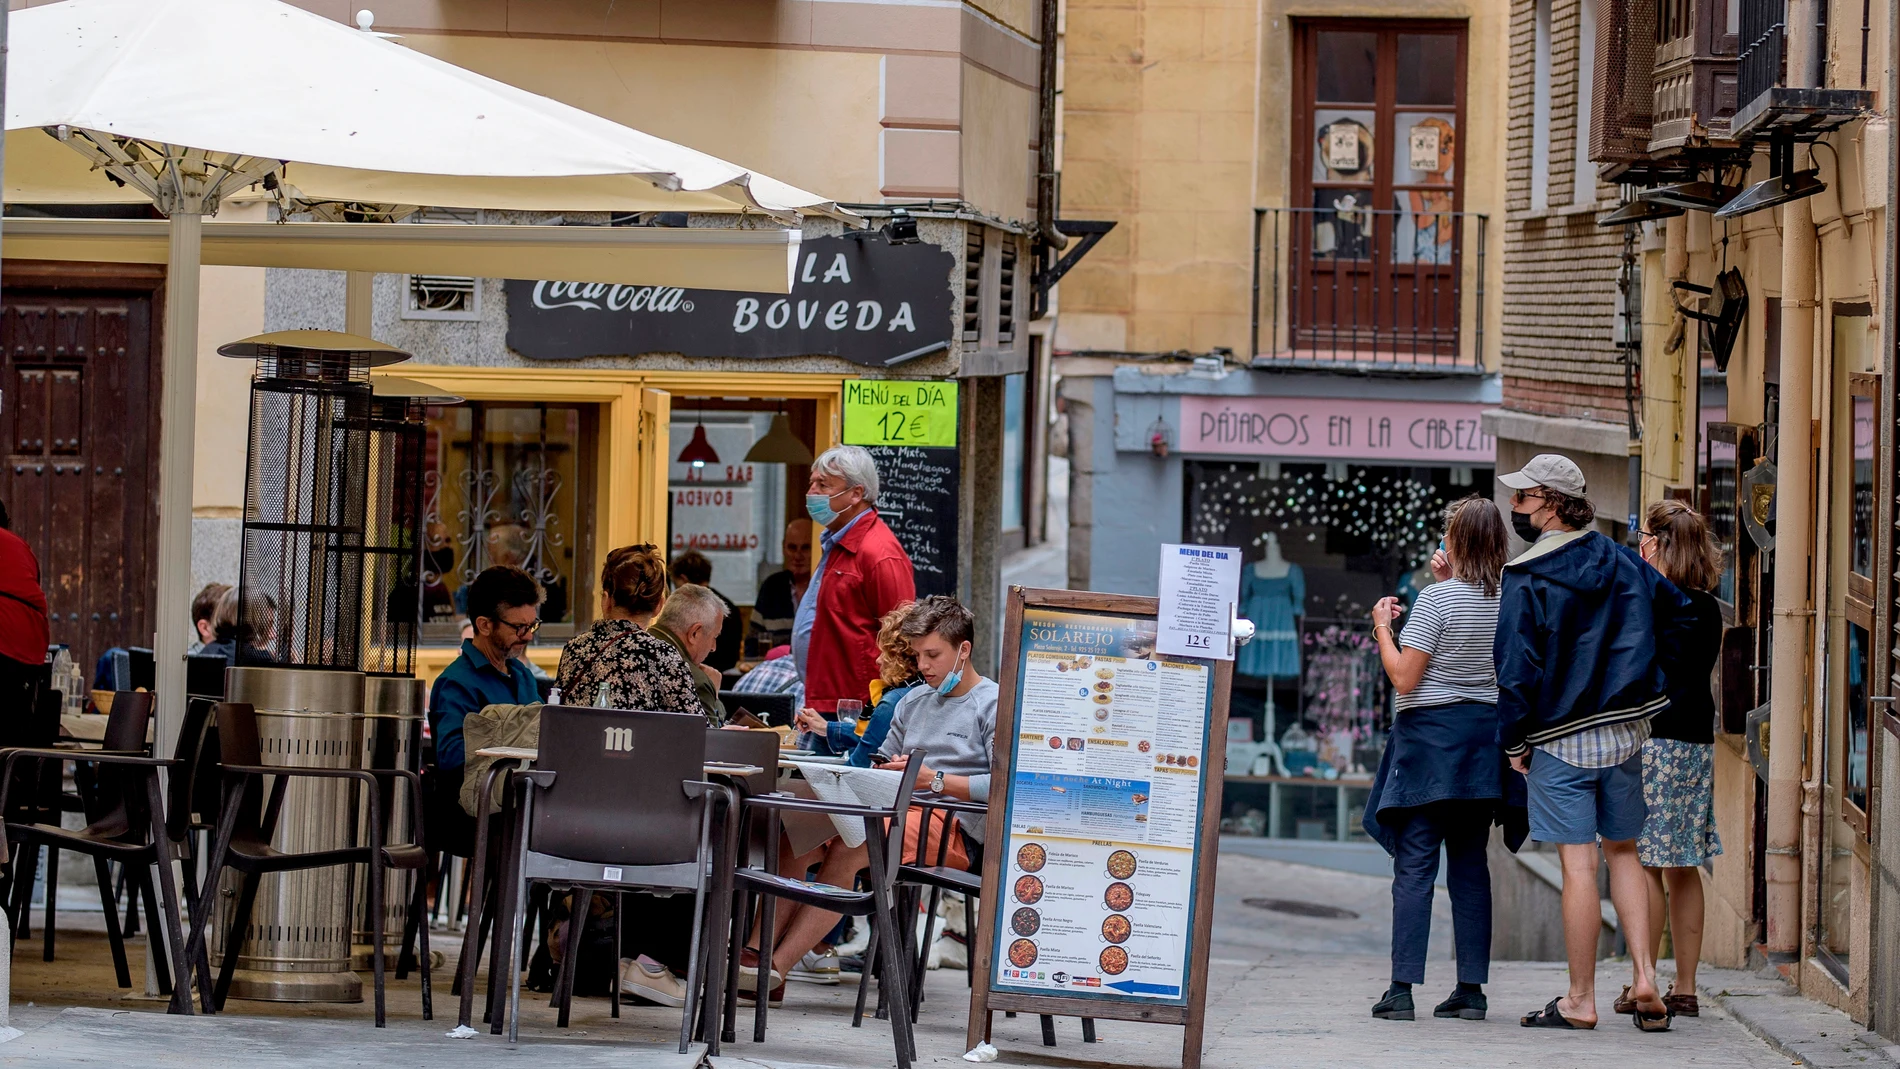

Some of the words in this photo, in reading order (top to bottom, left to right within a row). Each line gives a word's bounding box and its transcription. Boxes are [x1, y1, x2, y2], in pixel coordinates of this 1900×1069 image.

[800, 252, 851, 284] LA
[733, 298, 916, 333] BOVEDA
[848, 383, 890, 405] MENÚ
[893, 395, 911, 407] DEL
[916, 384, 946, 407] DÍA
[1200, 406, 1311, 445] PÁJAROS
[1328, 414, 1352, 447] EN
[1368, 416, 1391, 448] LA
[1179, 548, 1200, 557] MENU
[1201, 551, 1214, 559] DEL
[1215, 552, 1228, 560] DIA
[1029, 627, 1114, 648] SOLAREJO
[1187, 634, 1200, 645] 12
[1161, 662, 1184, 670] RACIONES
[1087, 738, 1114, 746] ENSALADAS
[1104, 778, 1132, 789] Night
[1092, 839, 1112, 847] PAELLAS
